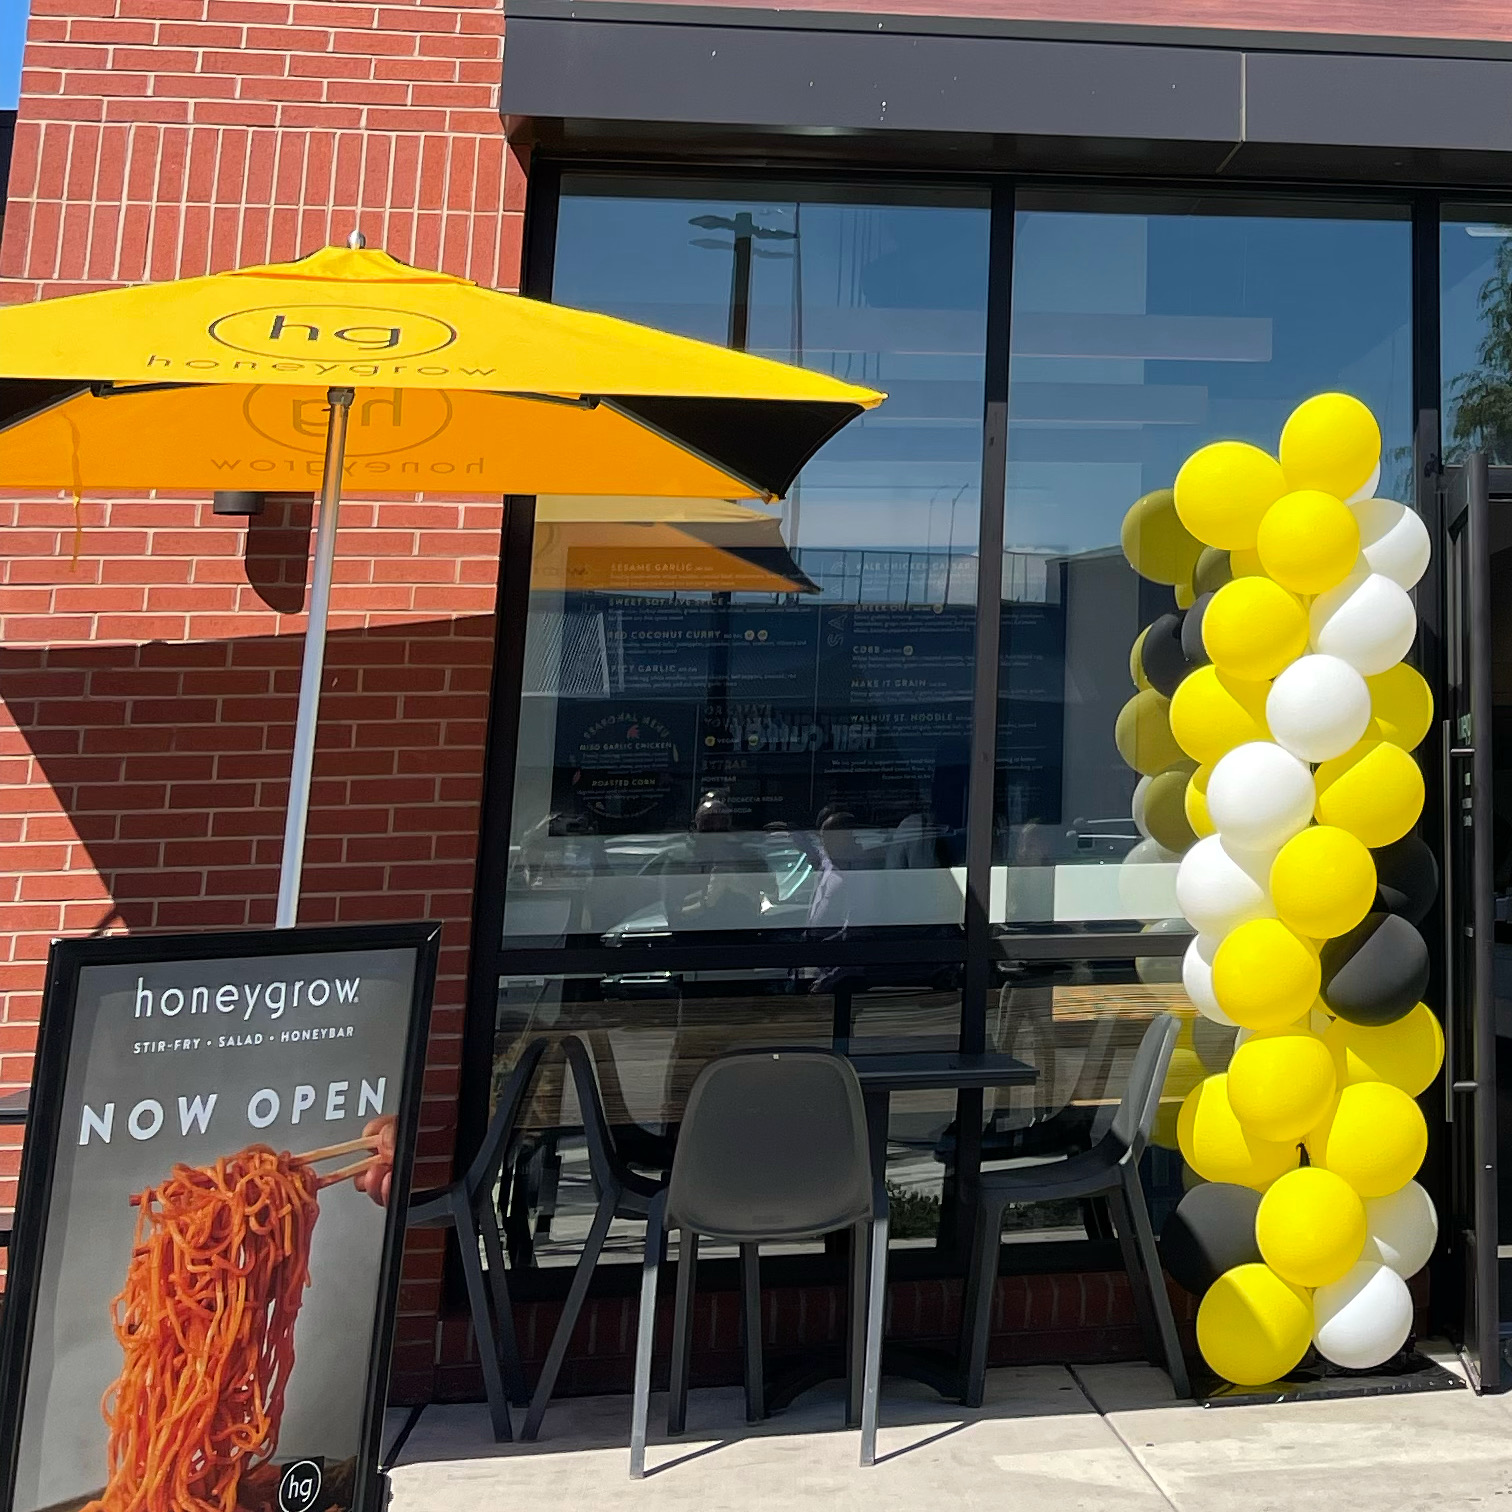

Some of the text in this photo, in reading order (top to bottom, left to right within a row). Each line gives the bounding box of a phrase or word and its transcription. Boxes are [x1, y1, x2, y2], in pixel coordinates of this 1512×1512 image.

[269, 315, 400, 350] hg
[146, 354, 497, 377] honeygrow
[654, 563, 691, 571] GARLIC
[630, 631, 683, 639] COCONUT
[686, 631, 721, 639] CURRY
[637, 664, 676, 673] GARLIC
[851, 679, 880, 688] MAKE
[850, 714, 891, 723] WALNUT
[910, 713, 954, 722] NOODLE
[635, 742, 672, 750] CHICKEN
[133, 977, 361, 1021] honeygrow
[133, 1026, 354, 1055] STIR-FRY SALAD HONEYBAR
[78, 1076, 387, 1146] NOW OPEN
[287, 1473, 313, 1503] hg
